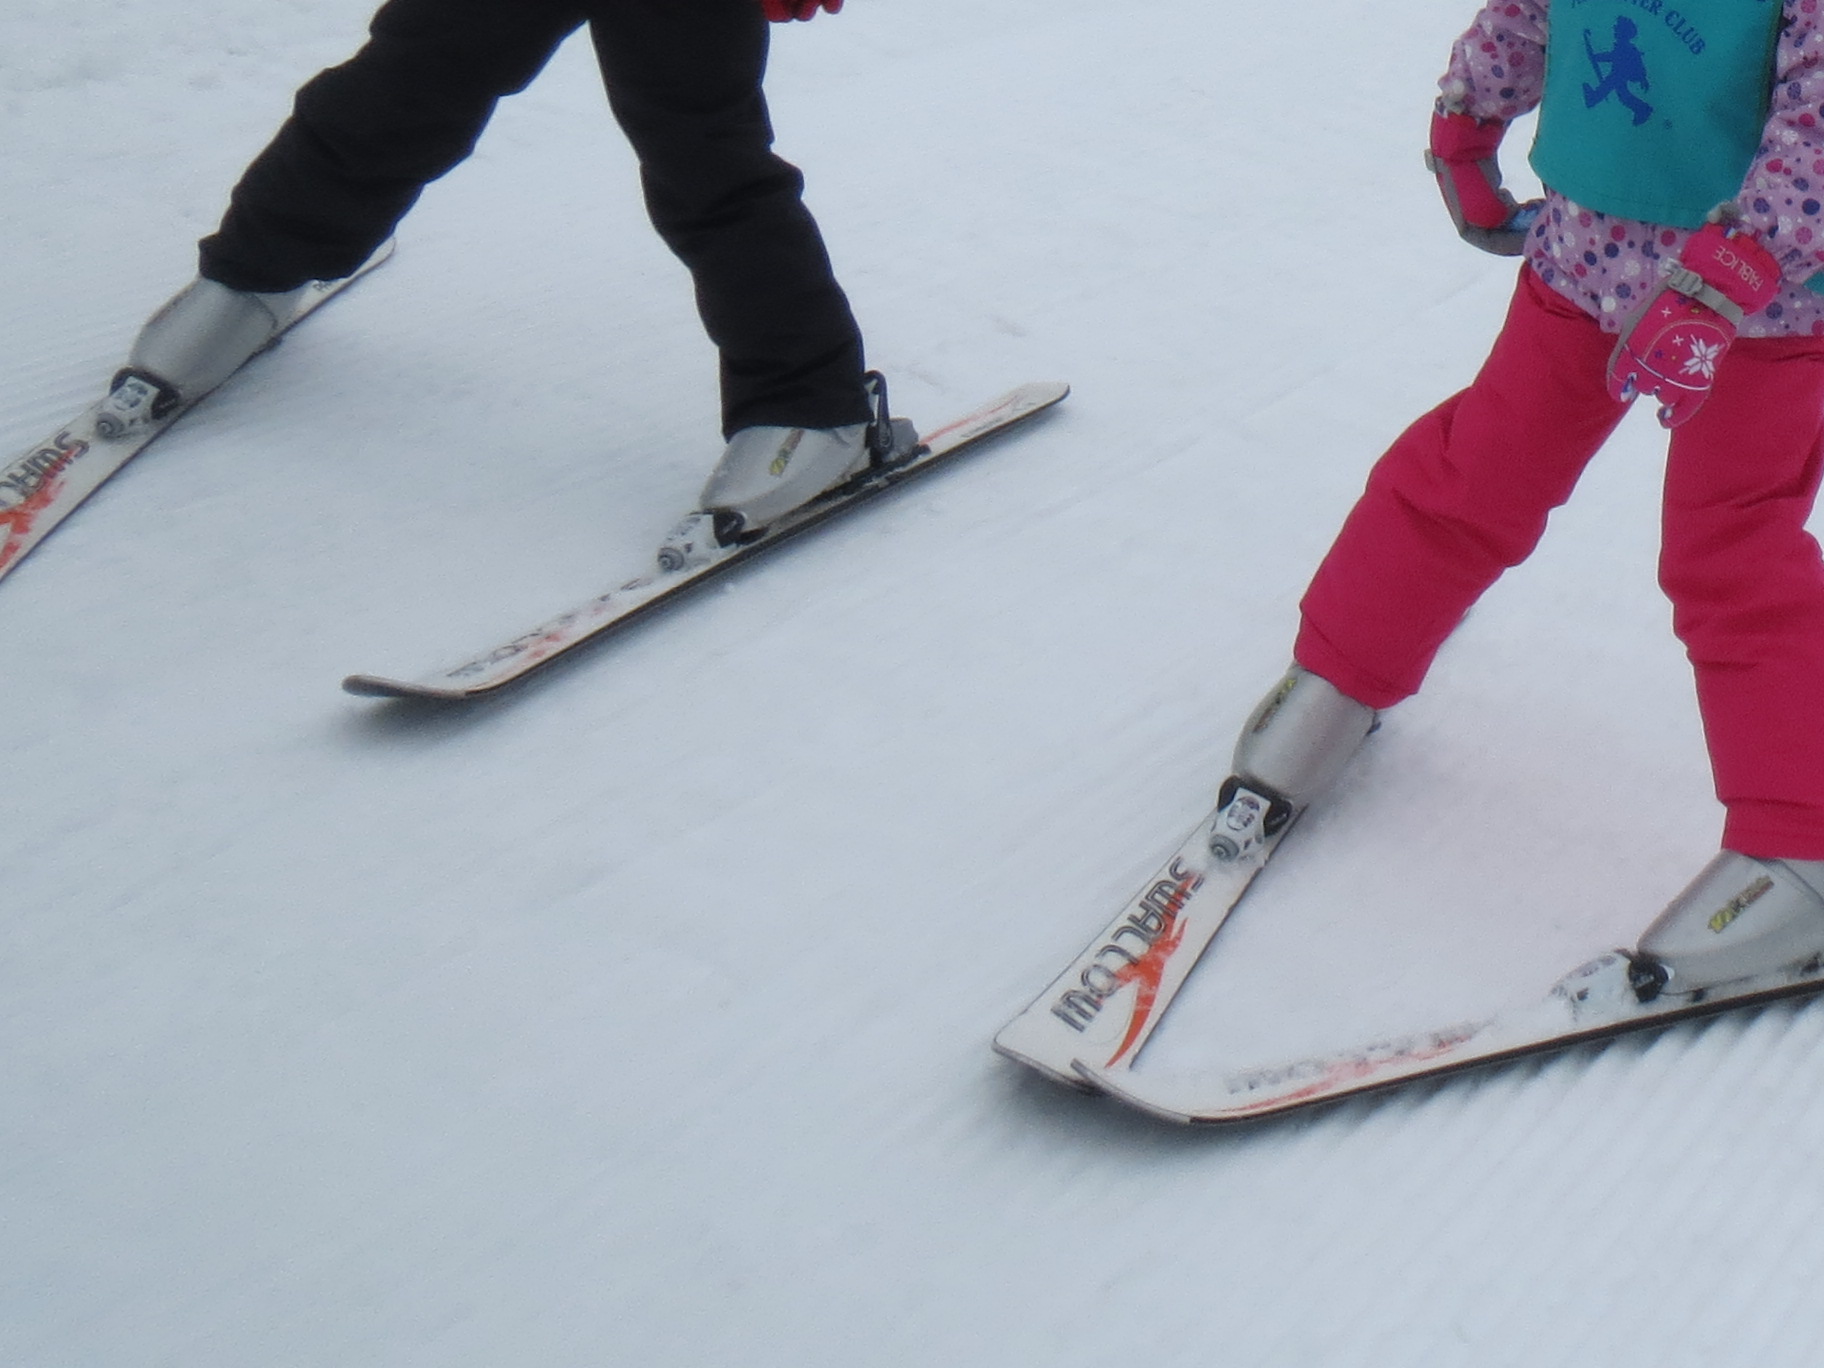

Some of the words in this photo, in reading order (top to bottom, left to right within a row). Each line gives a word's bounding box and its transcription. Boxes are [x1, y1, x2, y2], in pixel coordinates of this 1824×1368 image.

[1664, 10, 1706, 55] CLUB
[1712, 245, 1764, 292] FABLICE
[1050, 856, 1205, 1032] SWALLOW
